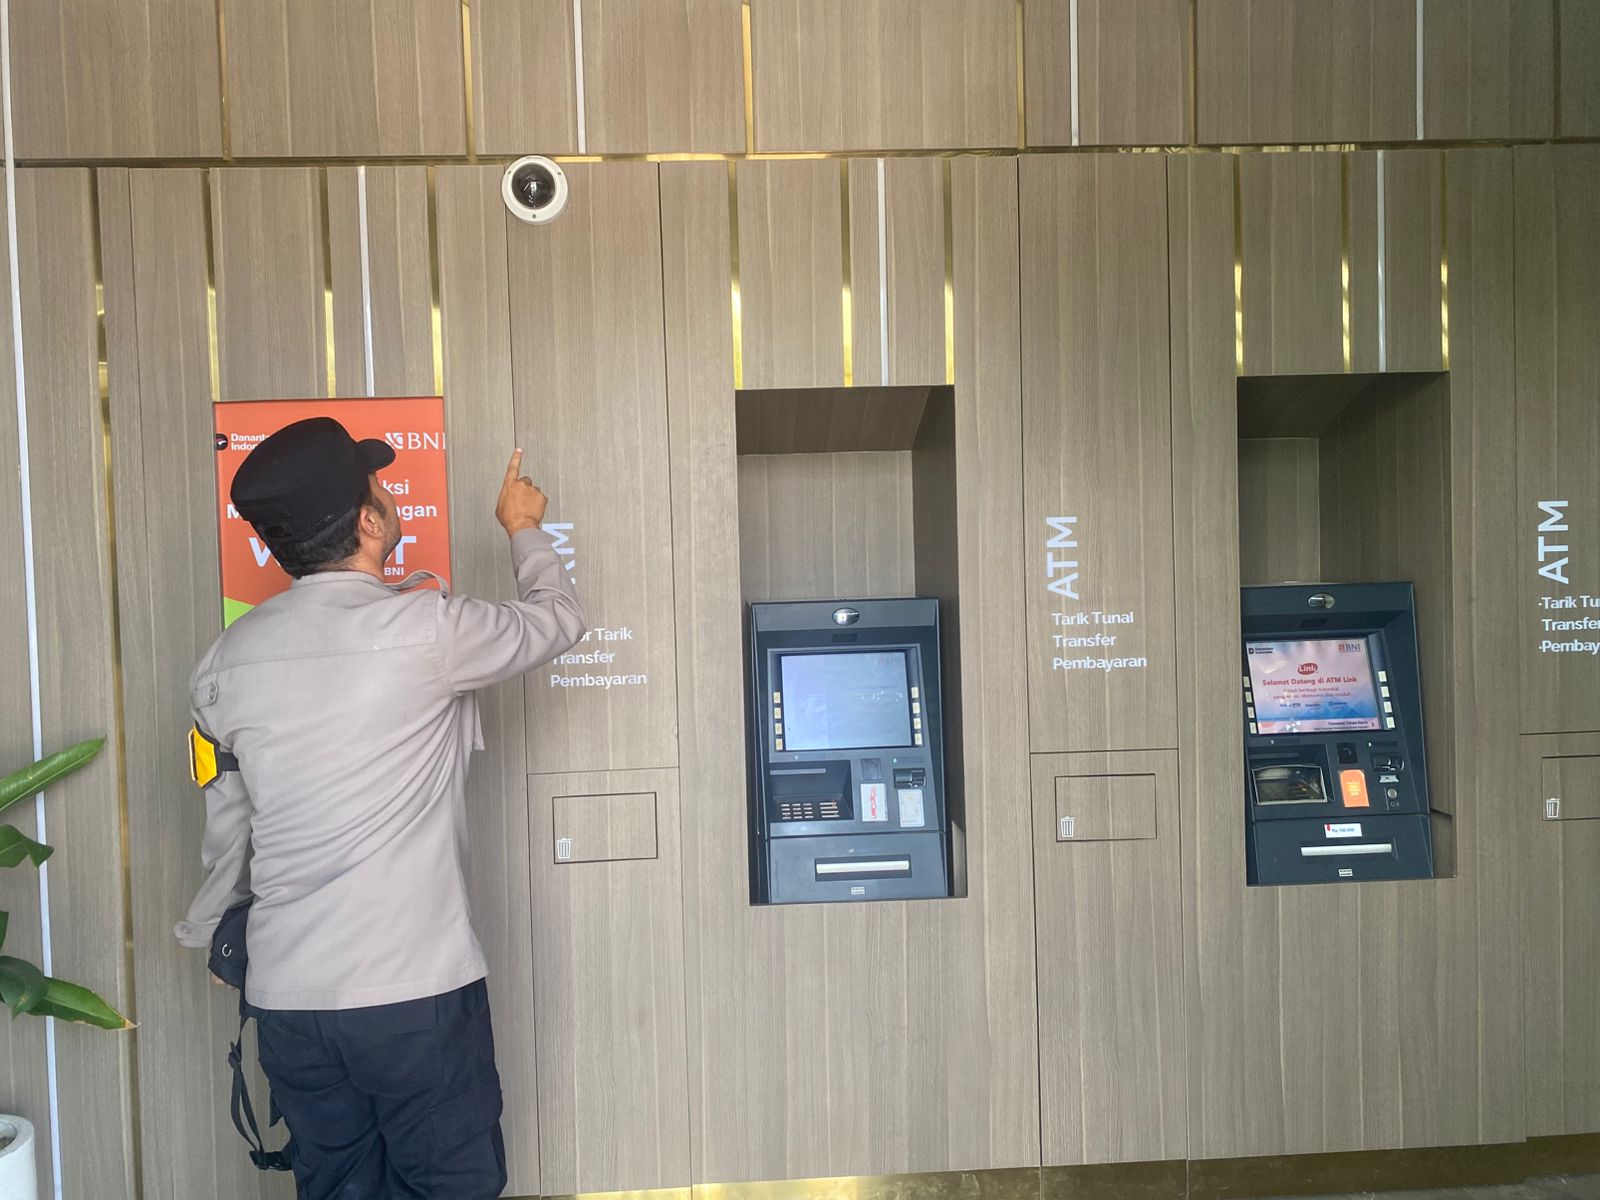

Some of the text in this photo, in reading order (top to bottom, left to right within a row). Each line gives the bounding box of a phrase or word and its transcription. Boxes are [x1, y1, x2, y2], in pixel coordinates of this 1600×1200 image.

[231, 433, 270, 441] Danant
[408, 432, 446, 450] BNI
[1537, 500, 1569, 585] ATM
[1046, 516, 1079, 600] ATM
[384, 567, 404, 576] BNI
[1541, 596, 1577, 609] Tarik
[1052, 611, 1134, 625] Tarik Tunai
[594, 627, 633, 641] Tarik
[1053, 633, 1117, 648] Transfer
[1053, 656, 1147, 672] Pembayaran
[550, 674, 647, 689] Pembayaran
